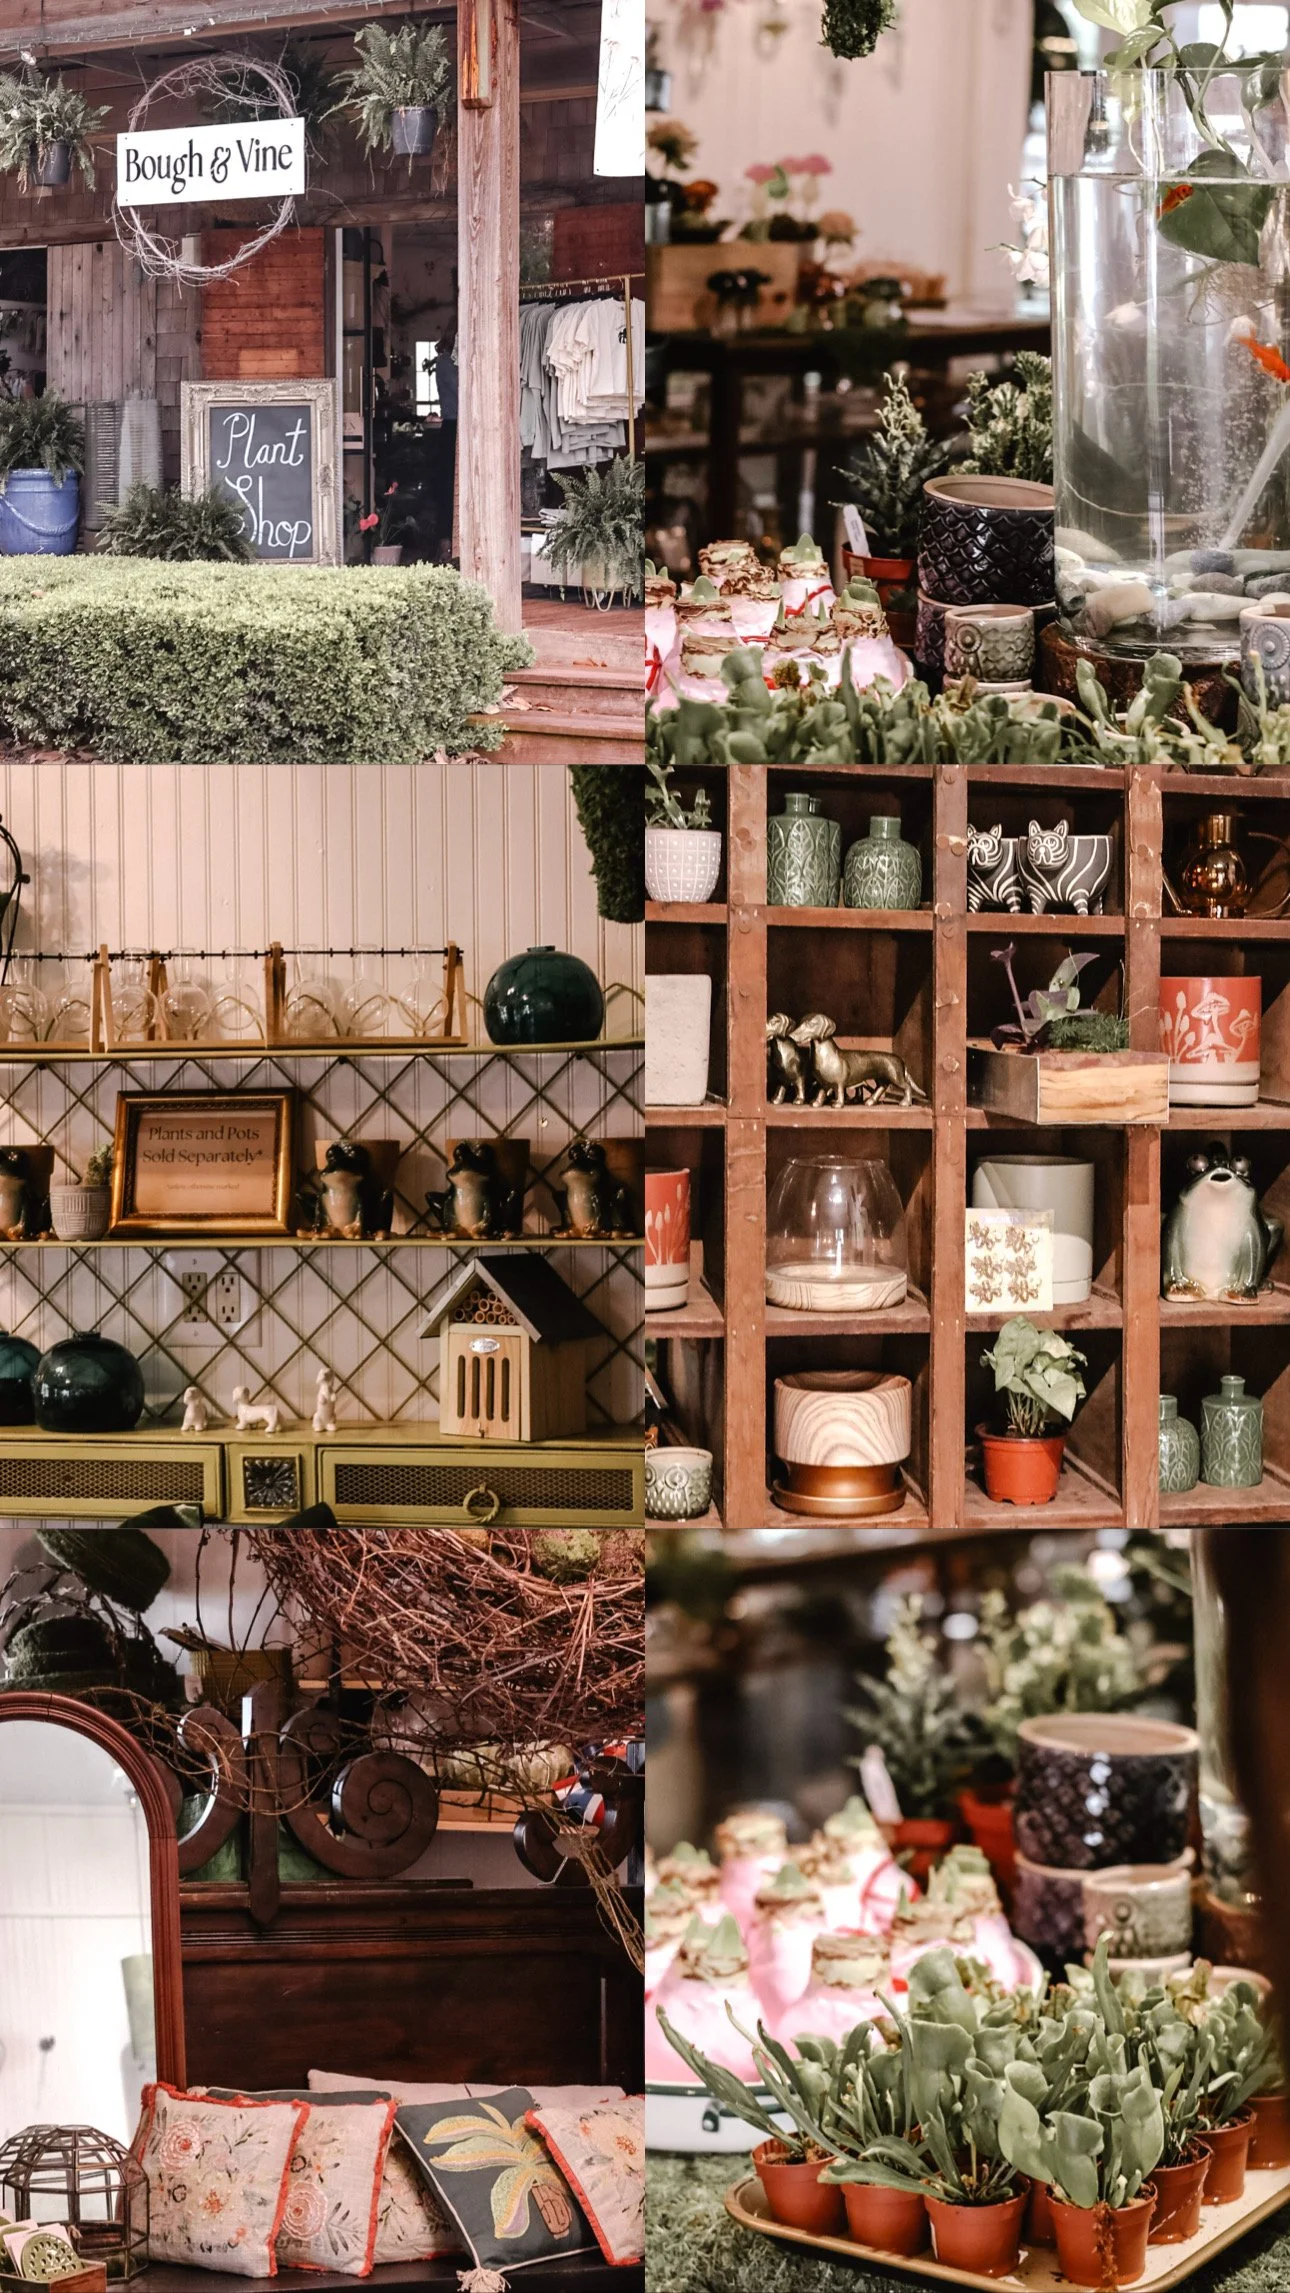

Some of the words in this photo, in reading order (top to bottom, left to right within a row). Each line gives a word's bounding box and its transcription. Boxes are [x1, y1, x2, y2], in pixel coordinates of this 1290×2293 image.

[126, 139, 203, 195] Bough
[210, 146, 232, 184] &
[236, 138, 293, 173] Vine
[216, 412, 308, 469] Plant
[224, 474, 312, 559] Shop
[142, 1148, 176, 1163] Sold
[149, 1126, 193, 1141] Plants
[195, 1125, 225, 1140] and
[227, 1126, 261, 1140] Pots
